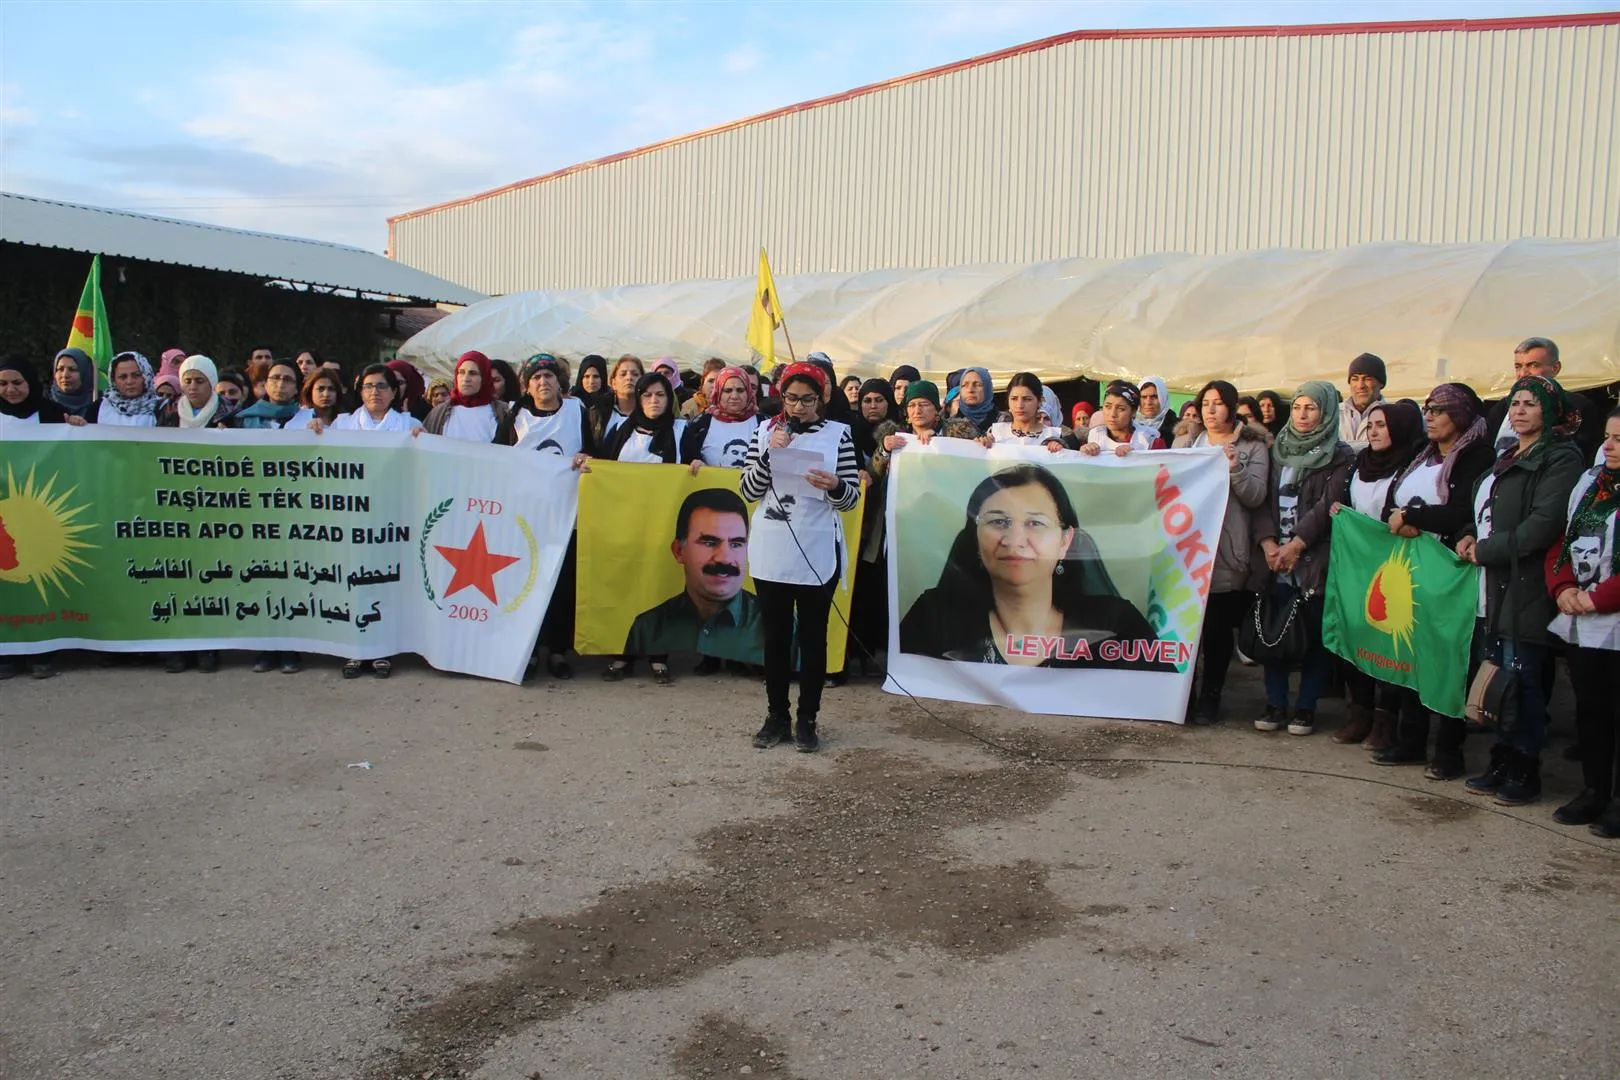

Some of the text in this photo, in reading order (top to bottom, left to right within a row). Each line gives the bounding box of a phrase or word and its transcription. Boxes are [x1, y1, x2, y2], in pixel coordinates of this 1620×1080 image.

[158, 455, 364, 482] TECRÎDÊ BIŞKÎNIN
[156, 486, 370, 513] FAŞÎZMÊ TÊK BIBIN
[466, 497, 503, 516] PYD
[116, 516, 410, 545] RÊBER APO RE AZAD BIJÎN
[127, 557, 193, 585] الفاشية
[198, 558, 234, 584] على
[293, 559, 342, 586] العزلة
[346, 563, 401, 592] لنحطم
[182, 593, 230, 617] القائد
[235, 601, 261, 621] مع
[319, 598, 350, 624] نحيا
[355, 600, 382, 633] كي
[447, 604, 489, 622] 2003
[1006, 633, 1195, 664] LEYLA GUVEN
